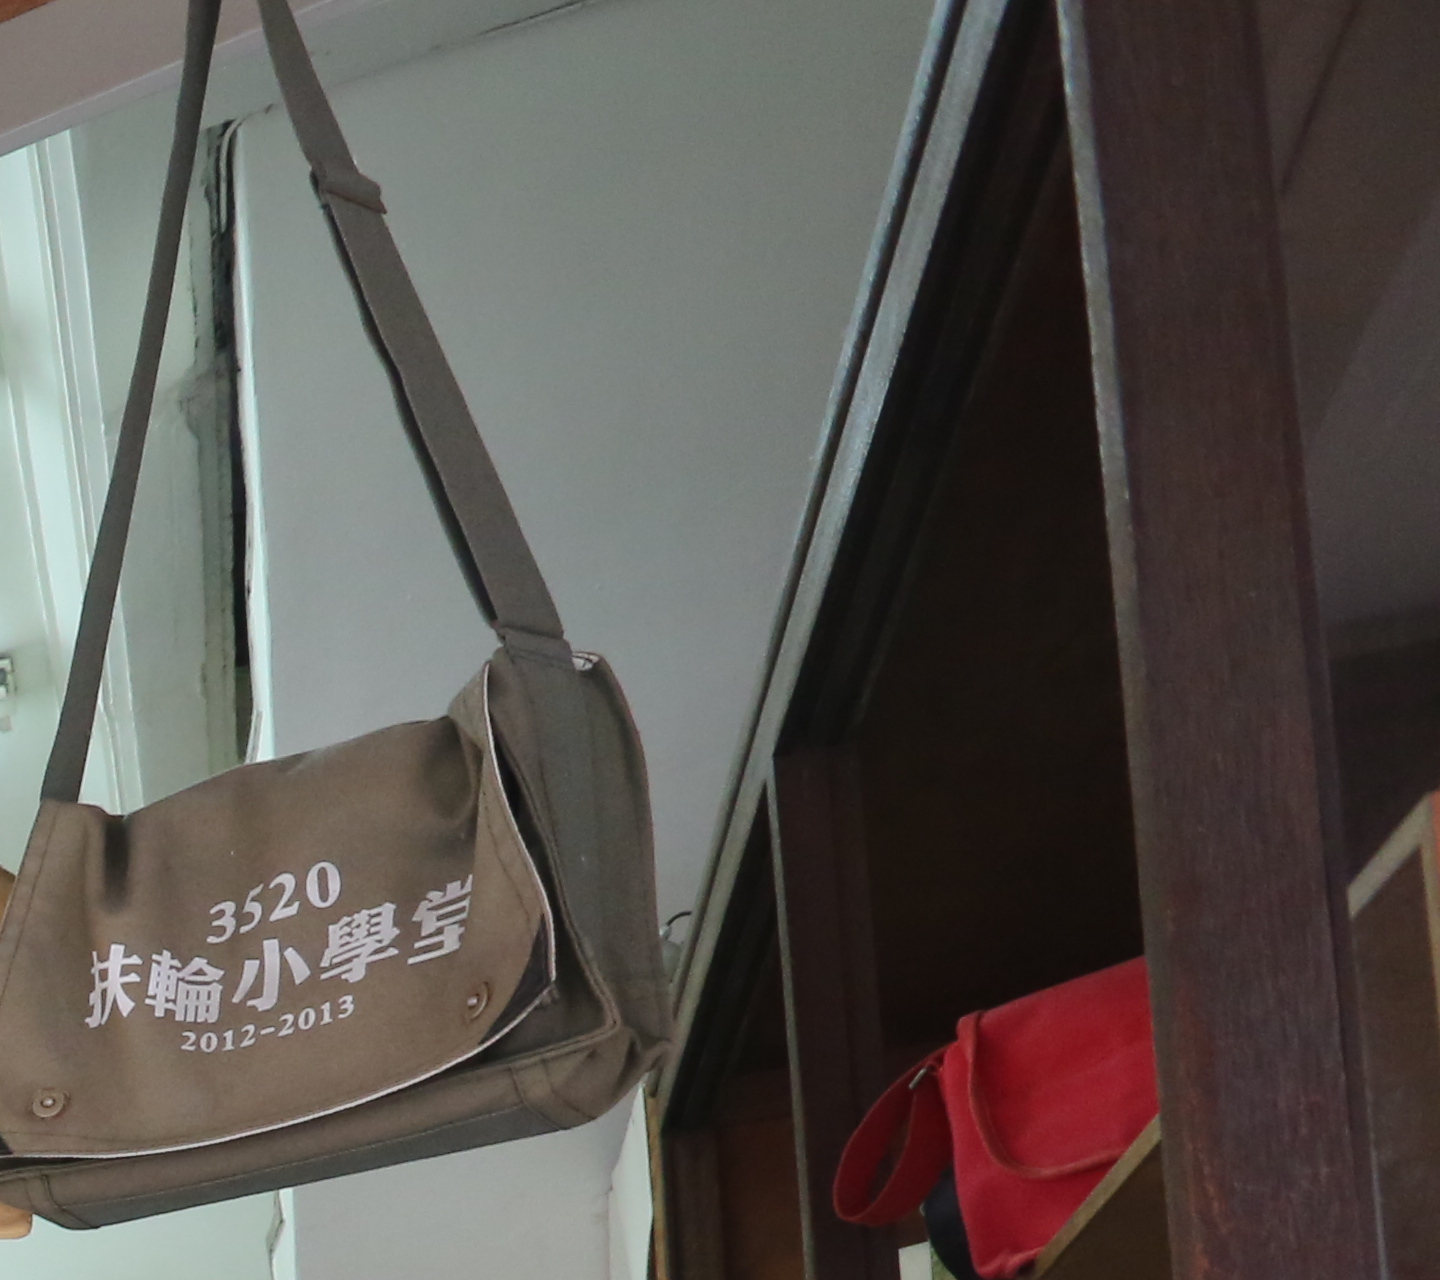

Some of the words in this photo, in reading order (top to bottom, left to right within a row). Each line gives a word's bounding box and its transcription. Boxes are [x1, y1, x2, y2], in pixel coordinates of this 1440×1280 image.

[206, 861, 341, 943] 3520
[85, 874, 473, 1028] 扶輪小學堂
[181, 994, 355, 1053] 2012-2013
